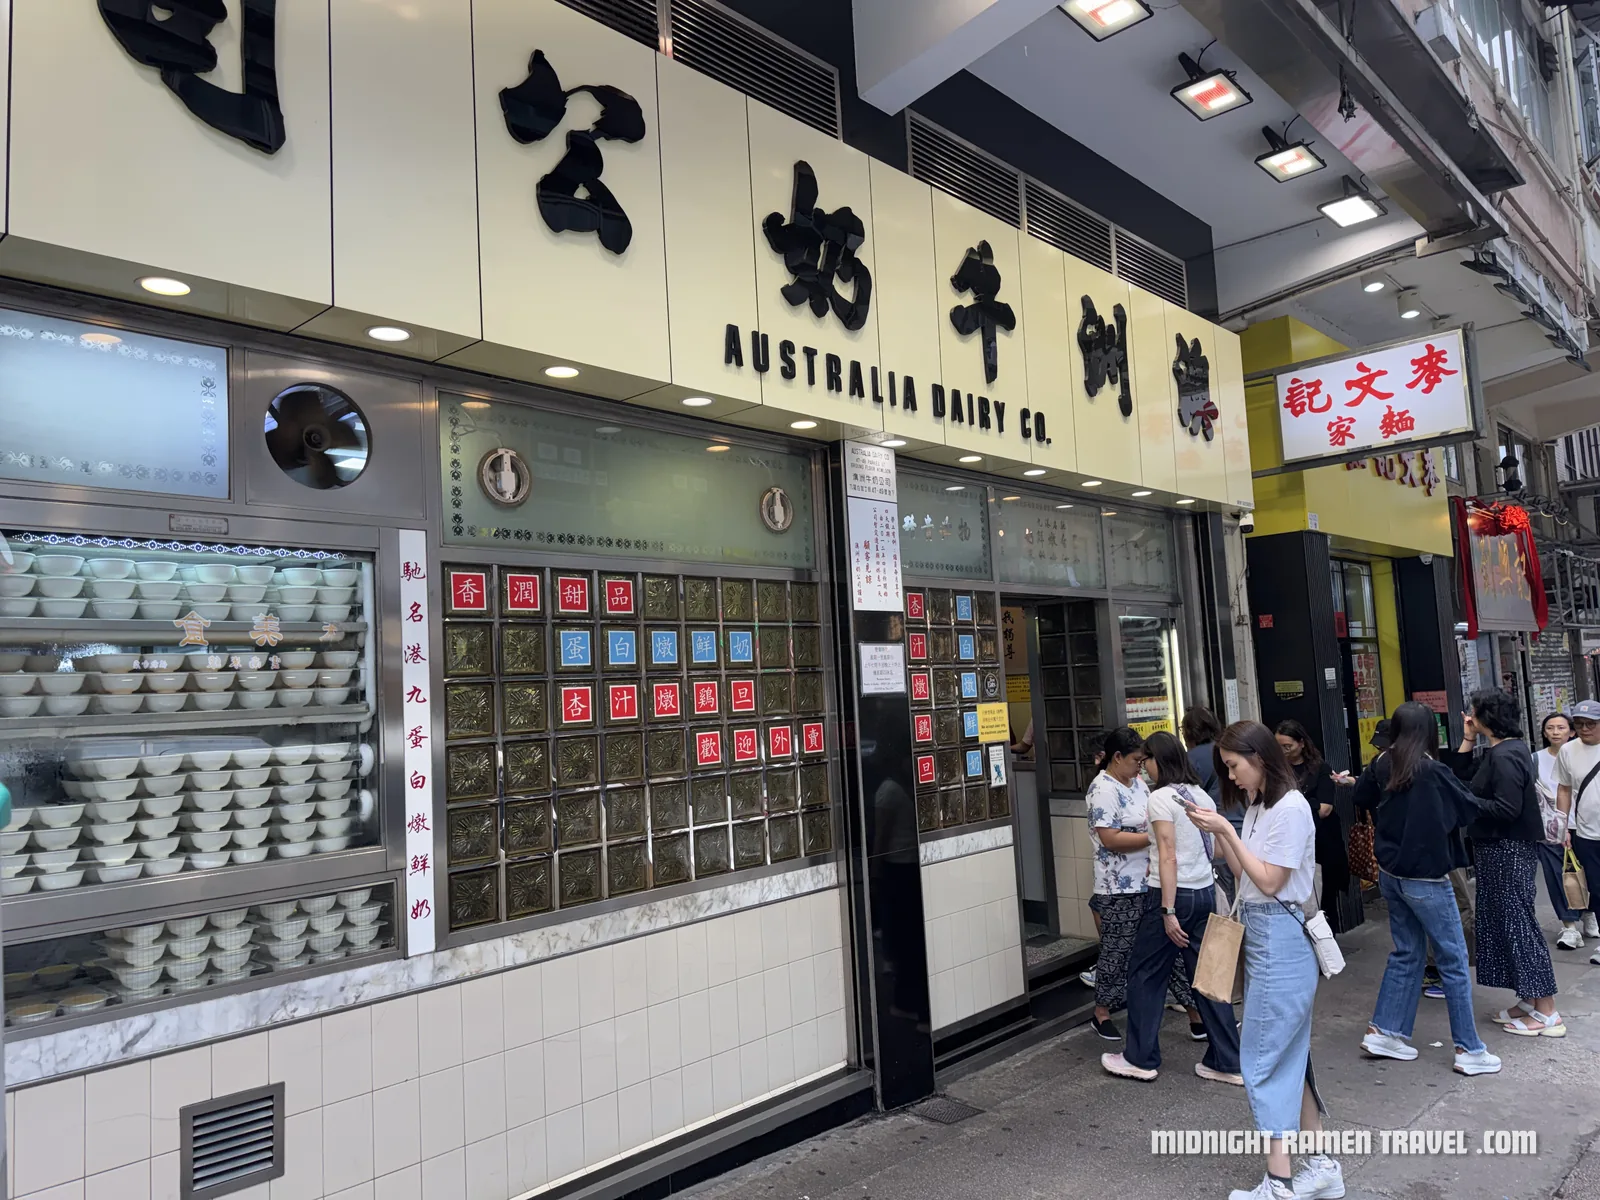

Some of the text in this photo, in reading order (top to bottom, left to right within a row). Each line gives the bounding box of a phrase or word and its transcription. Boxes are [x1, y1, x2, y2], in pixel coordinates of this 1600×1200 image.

[725, 324, 1052, 444] AUSTRALIA DAIRY CO.
[1283, 343, 1459, 418] 麥文記
[1326, 405, 1415, 447] 麵家
[456, 578, 629, 606] 香潤甜品
[564, 632, 752, 661] 蛋白燉鮮奶
[401, 561, 431, 921] 馳名港九蛋白燉鮮奶
[699, 727, 820, 761] 歡迎外賣
